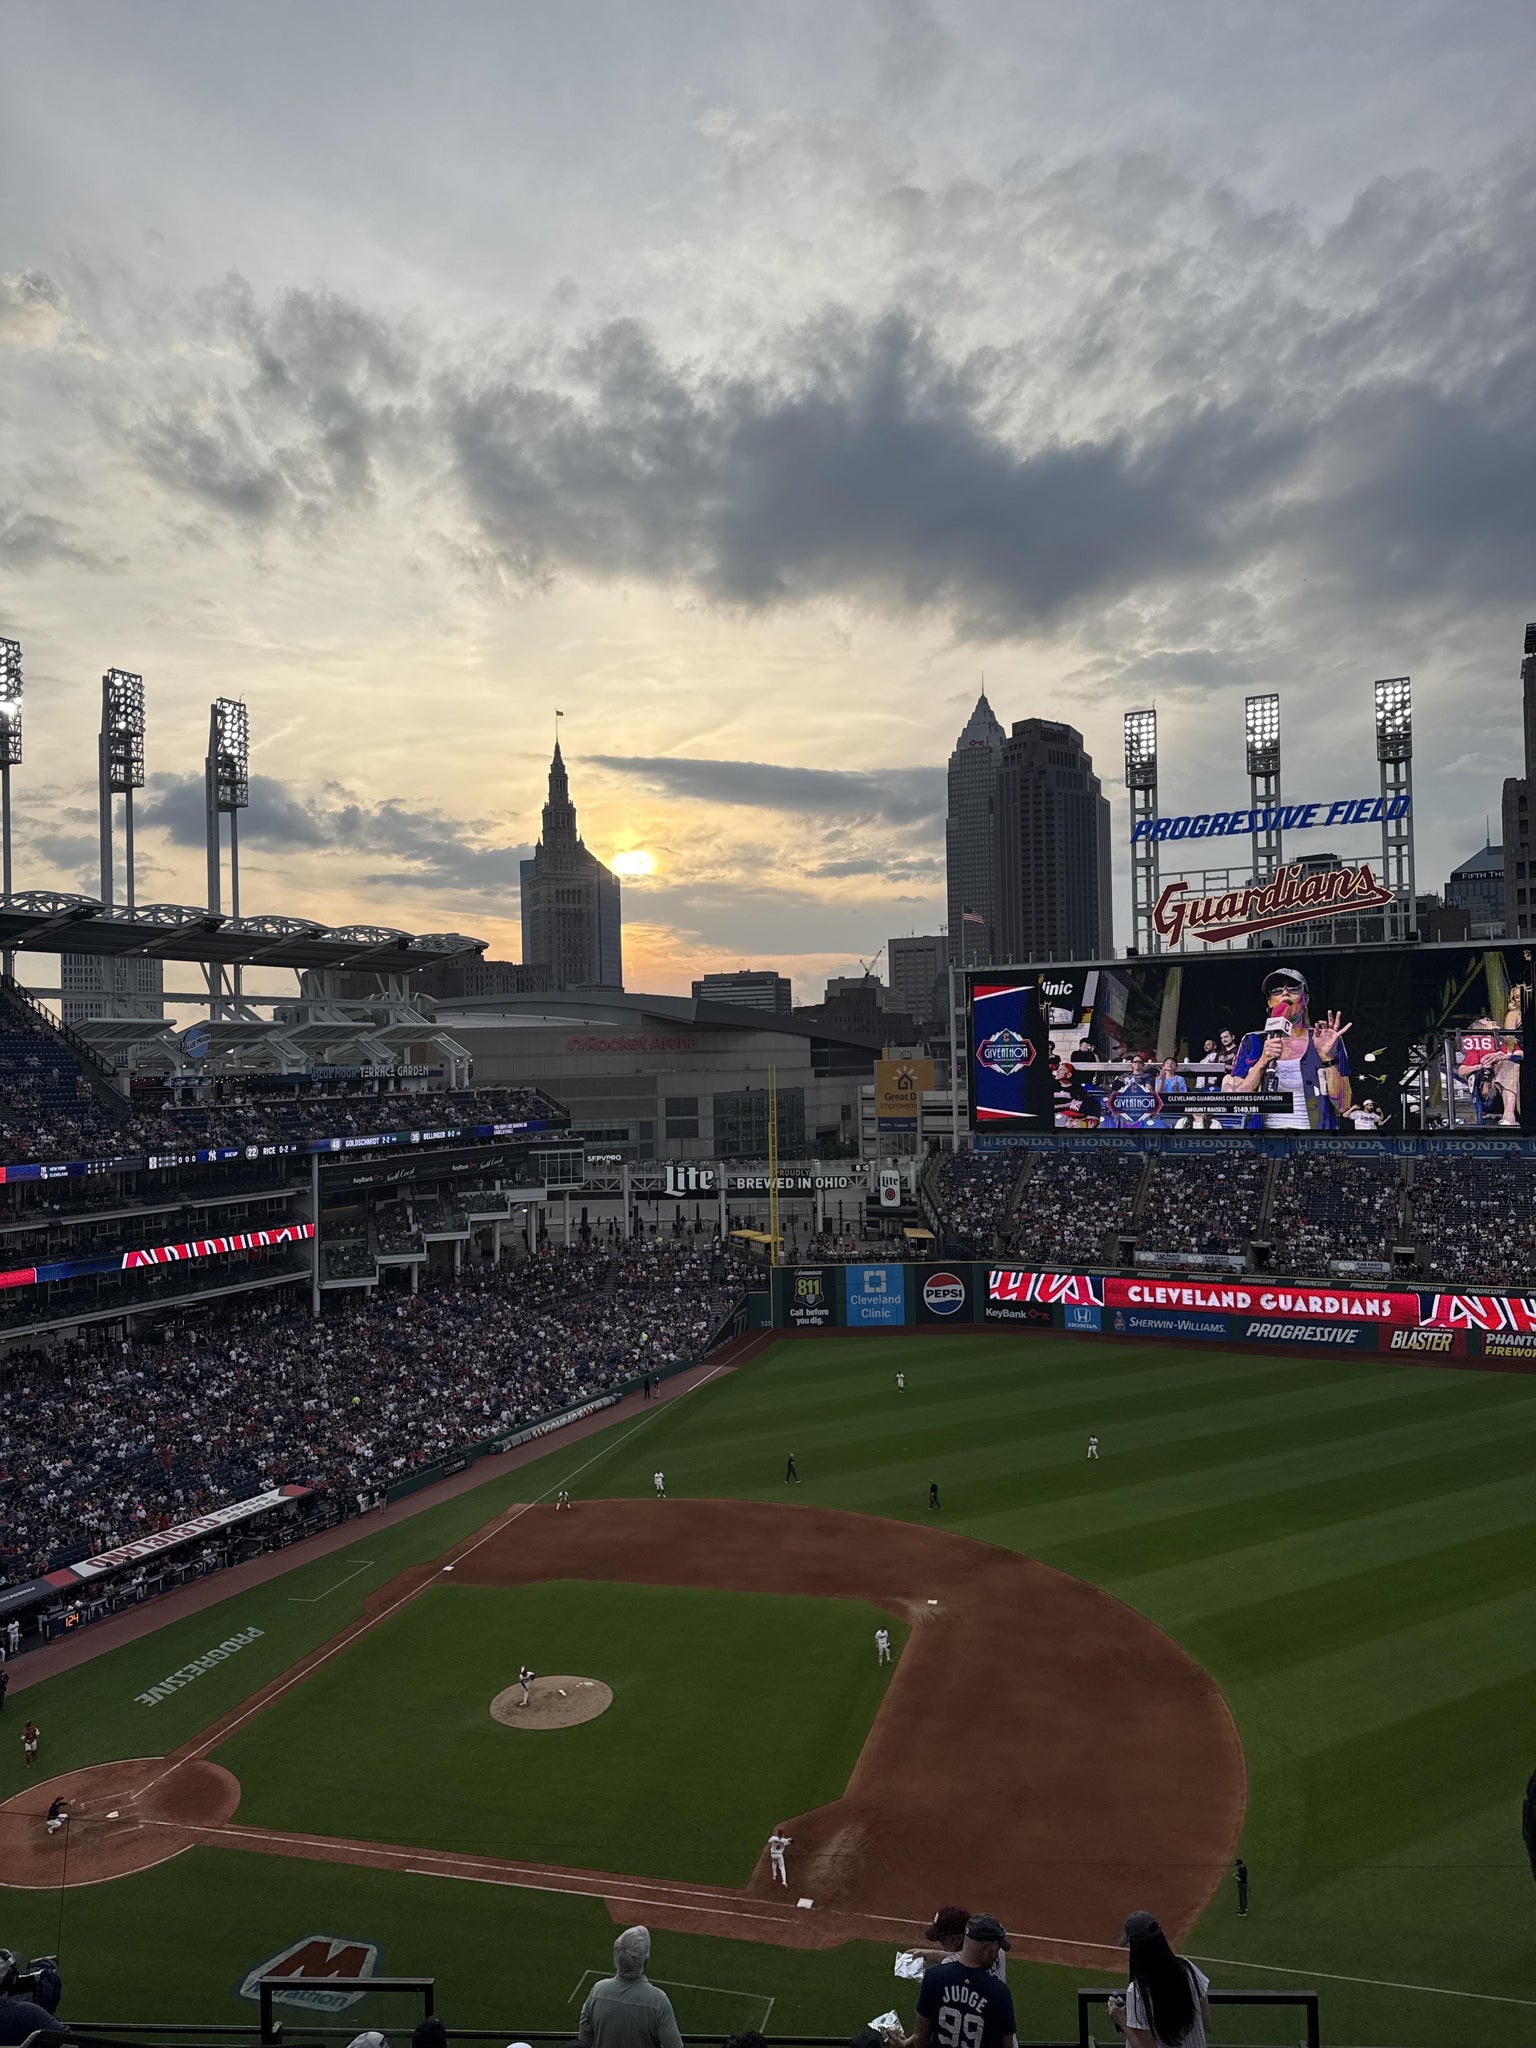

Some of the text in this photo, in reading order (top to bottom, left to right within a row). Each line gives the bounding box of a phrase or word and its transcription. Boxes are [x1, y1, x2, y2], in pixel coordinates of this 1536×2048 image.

[1130, 795, 1412, 844] PROGRESSIVE FIELD
[1461, 872, 1487, 880] FIFTH
[1152, 862, 1395, 948] Guardians
[588, 1036, 697, 1051] Rocket Arena
[1463, 1038, 1492, 1050] 316
[335, 1068, 357, 1079] MOON
[360, 1065, 396, 1078] TERRACE
[397, 1065, 429, 1077] GARDEN
[884, 1092, 908, 1101] Great
[1252, 1094, 1283, 1102] GIVEATHON
[423, 1131, 446, 1140] BELLINGER
[345, 1137, 380, 1147] GOLDSCHMIDT
[382, 1136, 391, 1144] 2-2
[995, 1138, 1053, 1146] HONDA
[1073, 1138, 1136, 1147] HONDA
[1187, 1139, 1255, 1149] HONDA
[1314, 1140, 1386, 1150] HONDA
[1443, 1141, 1523, 1150] HONDA
[263, 1147, 276, 1155] RICE
[279, 1145, 289, 1153] 0-2
[353, 1176, 374, 1184] KeyBank
[663, 1165, 714, 1197] Lite
[736, 1177, 848, 1189] BREWED IN OHIO
[882, 1176, 899, 1188] Lite
[1087, 1269, 1122, 1277] PROGRESSIVE
[1239, 1277, 1277, 1285] PROGRESSIVE
[1294, 1280, 1332, 1288] PROGRESSIVE
[797, 1279, 821, 1296] 811
[1465, 1288, 1507, 1296] PROGRESSIVE
[926, 1289, 962, 1298] PEPSI
[850, 1295, 901, 1305] Cleveland
[1128, 1285, 1251, 1309] CLEVELAND
[1259, 1293, 1392, 1317] GUARDIANS
[790, 1308, 829, 1317] Call before
[861, 1308, 891, 1318] Clinic
[985, 1308, 1027, 1320] KeyBank
[796, 1317, 824, 1326] you dig.
[1067, 1322, 1098, 1330] HONDA
[1129, 1316, 1227, 1333] SHERWIN-WILLIAMS.
[1246, 1323, 1359, 1344] PROGRESSIVE
[1390, 1330, 1454, 1352] BLASTER
[86, 1518, 221, 1569] CLEVELAND
[134, 1626, 265, 1708] PROGRESSIVE
[942, 1985, 988, 2014] JUDGE
[938, 2005, 985, 2048] 99
